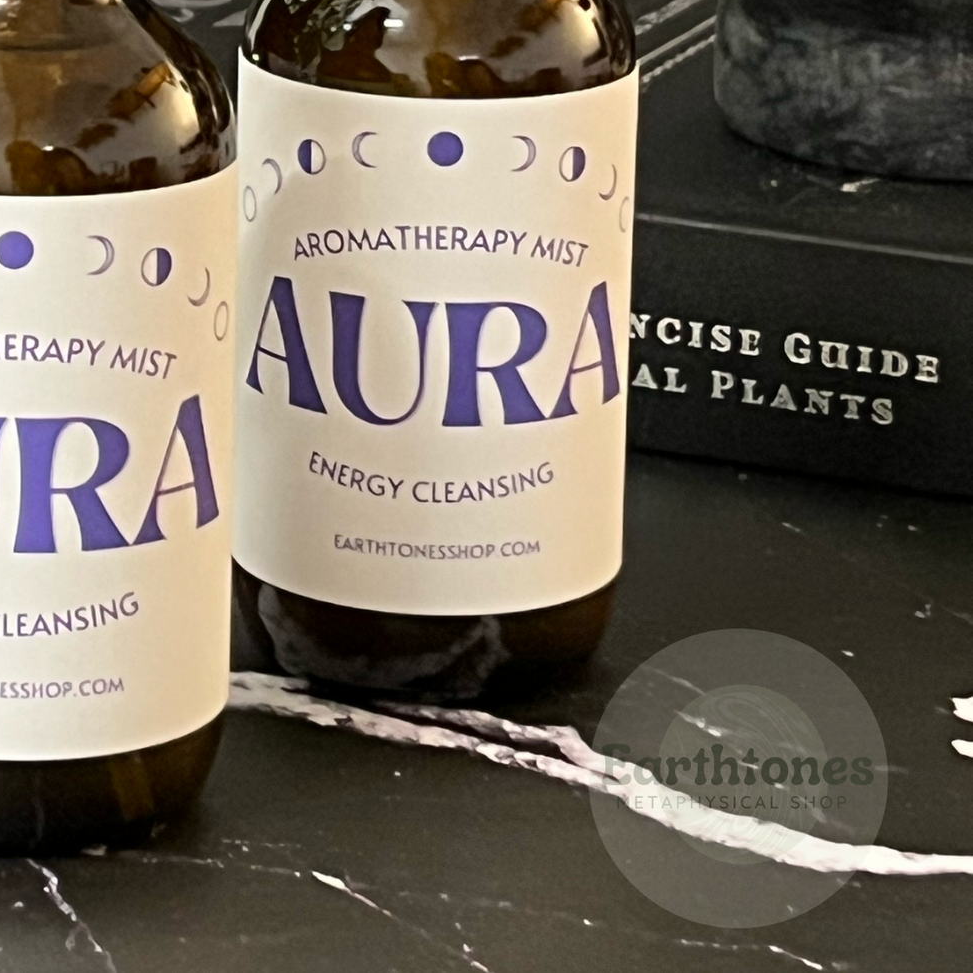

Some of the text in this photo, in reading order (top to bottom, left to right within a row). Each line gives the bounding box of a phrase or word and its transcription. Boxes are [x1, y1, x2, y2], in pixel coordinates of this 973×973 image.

[293, 225, 589, 268] AROMATHERAPY MIST
[110, 344, 177, 380] MIST
[245, 275, 621, 428] AURA
[710, 369, 894, 425] PLANTS
[308, 450, 555, 504] ENERGY CLEANSING
[333, 533, 541, 560] EARTHTONESSHOP.COM
